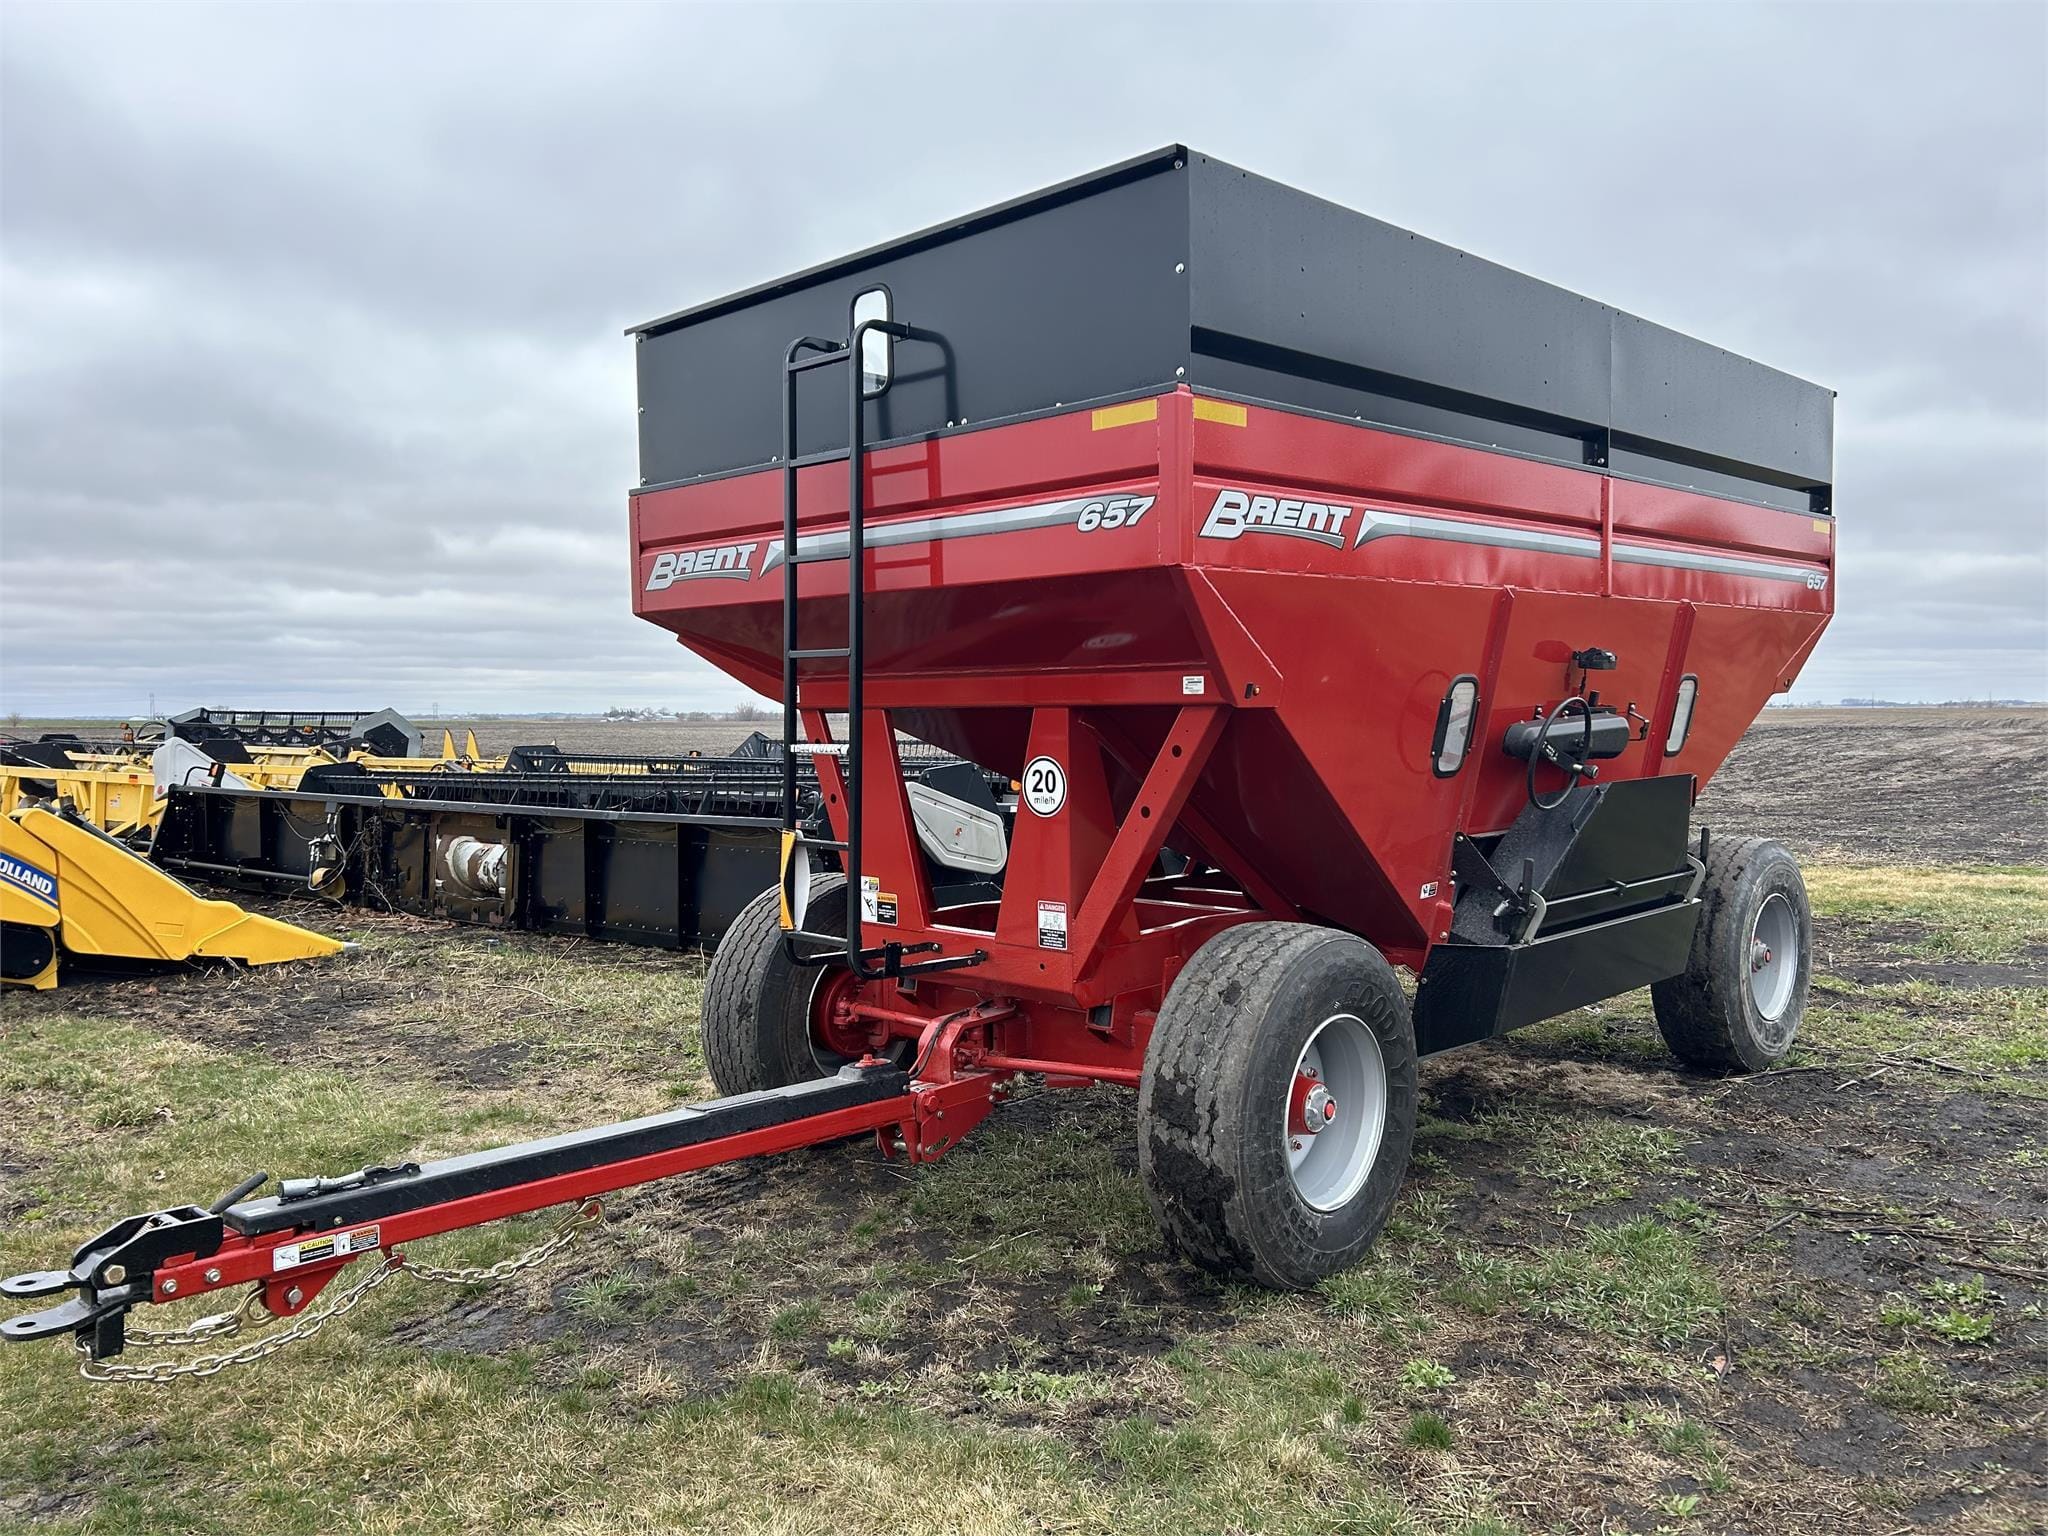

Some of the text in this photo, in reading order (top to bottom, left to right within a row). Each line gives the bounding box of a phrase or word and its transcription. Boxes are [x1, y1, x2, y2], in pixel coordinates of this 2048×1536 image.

[1077, 495, 1156, 533] 657
[1198, 489, 1352, 541] BRENT
[645, 543, 758, 592] BRENT
[1807, 573, 1828, 590] 657
[1031, 769, 1056, 794] 20
